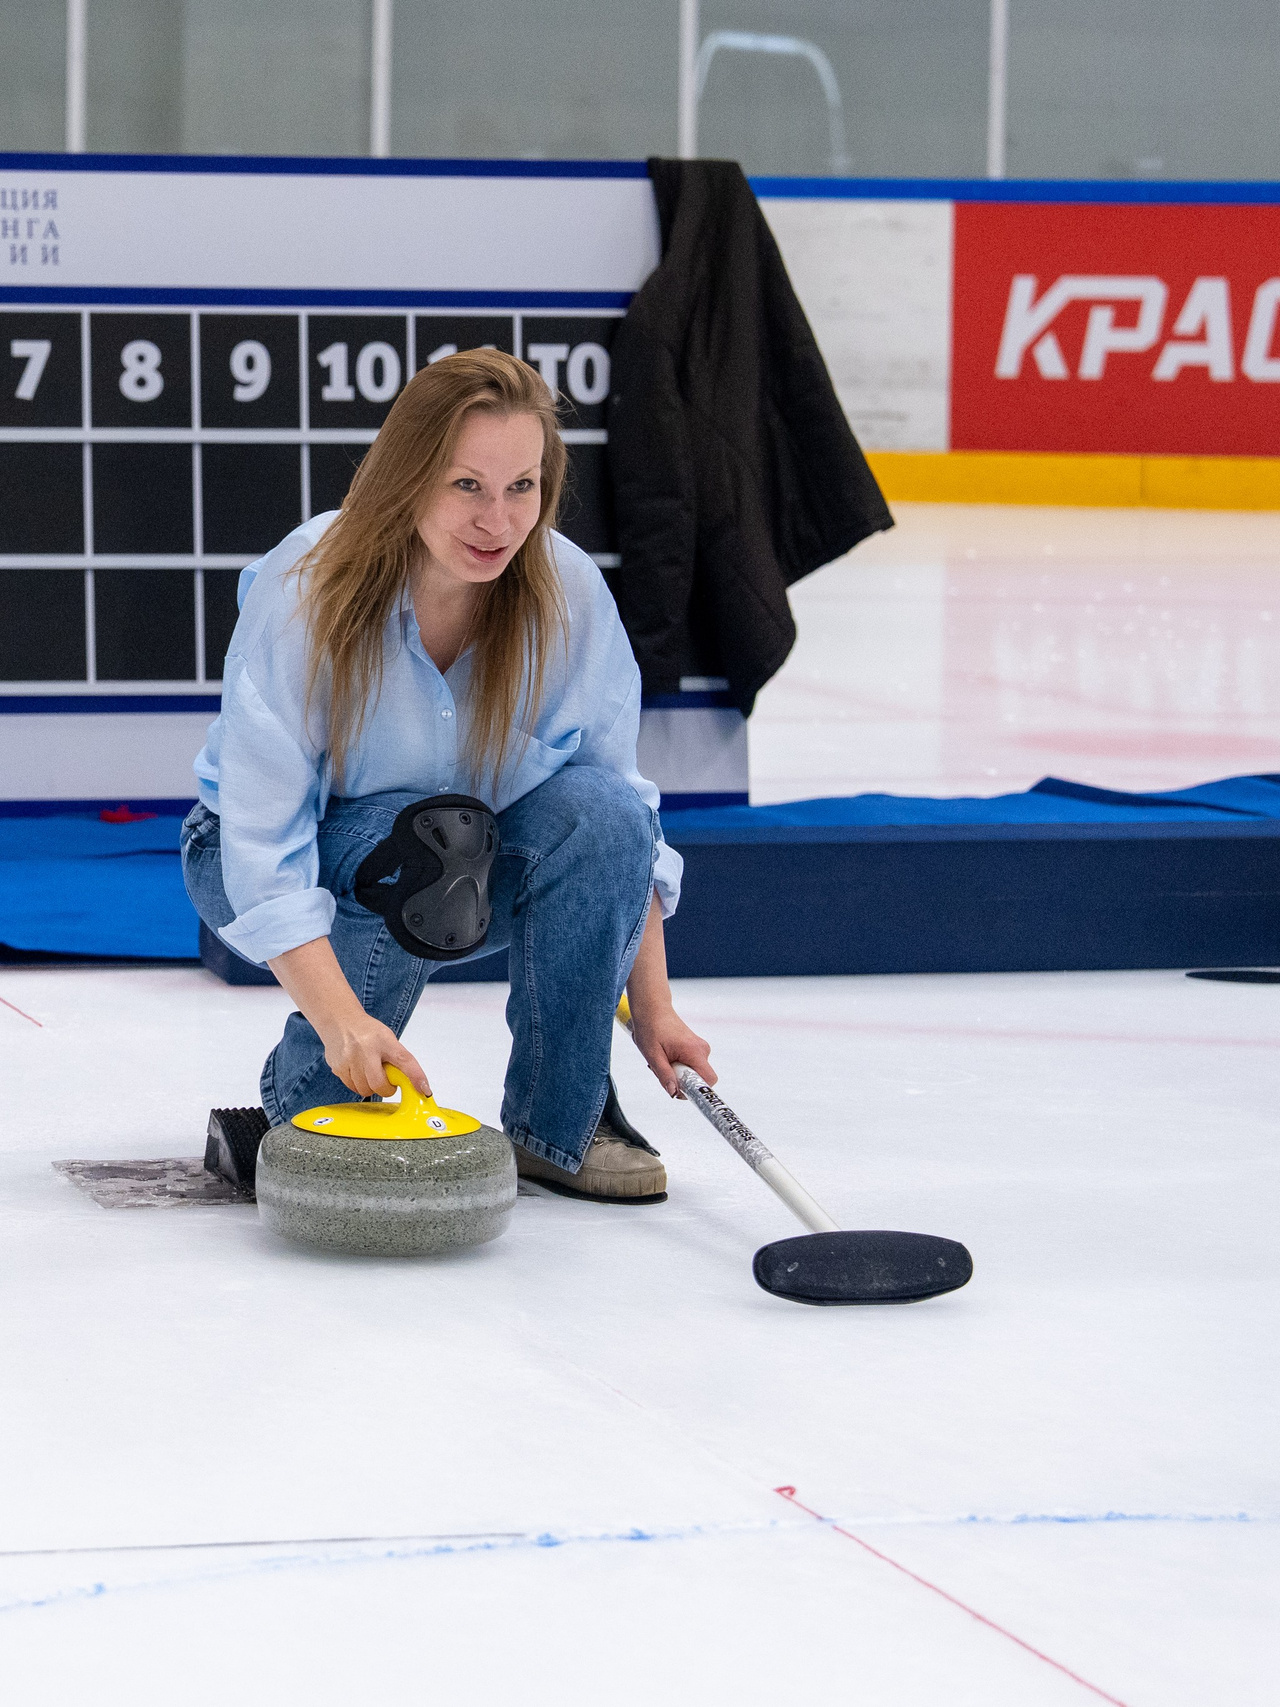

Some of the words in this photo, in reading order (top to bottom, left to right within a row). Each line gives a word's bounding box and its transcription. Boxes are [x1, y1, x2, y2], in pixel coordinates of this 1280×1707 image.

[11, 340, 51, 400] 7
[119, 340, 164, 402] 8
[230, 340, 271, 402] 9
[318, 342, 401, 403] 10
[527, 342, 611, 405] TO
